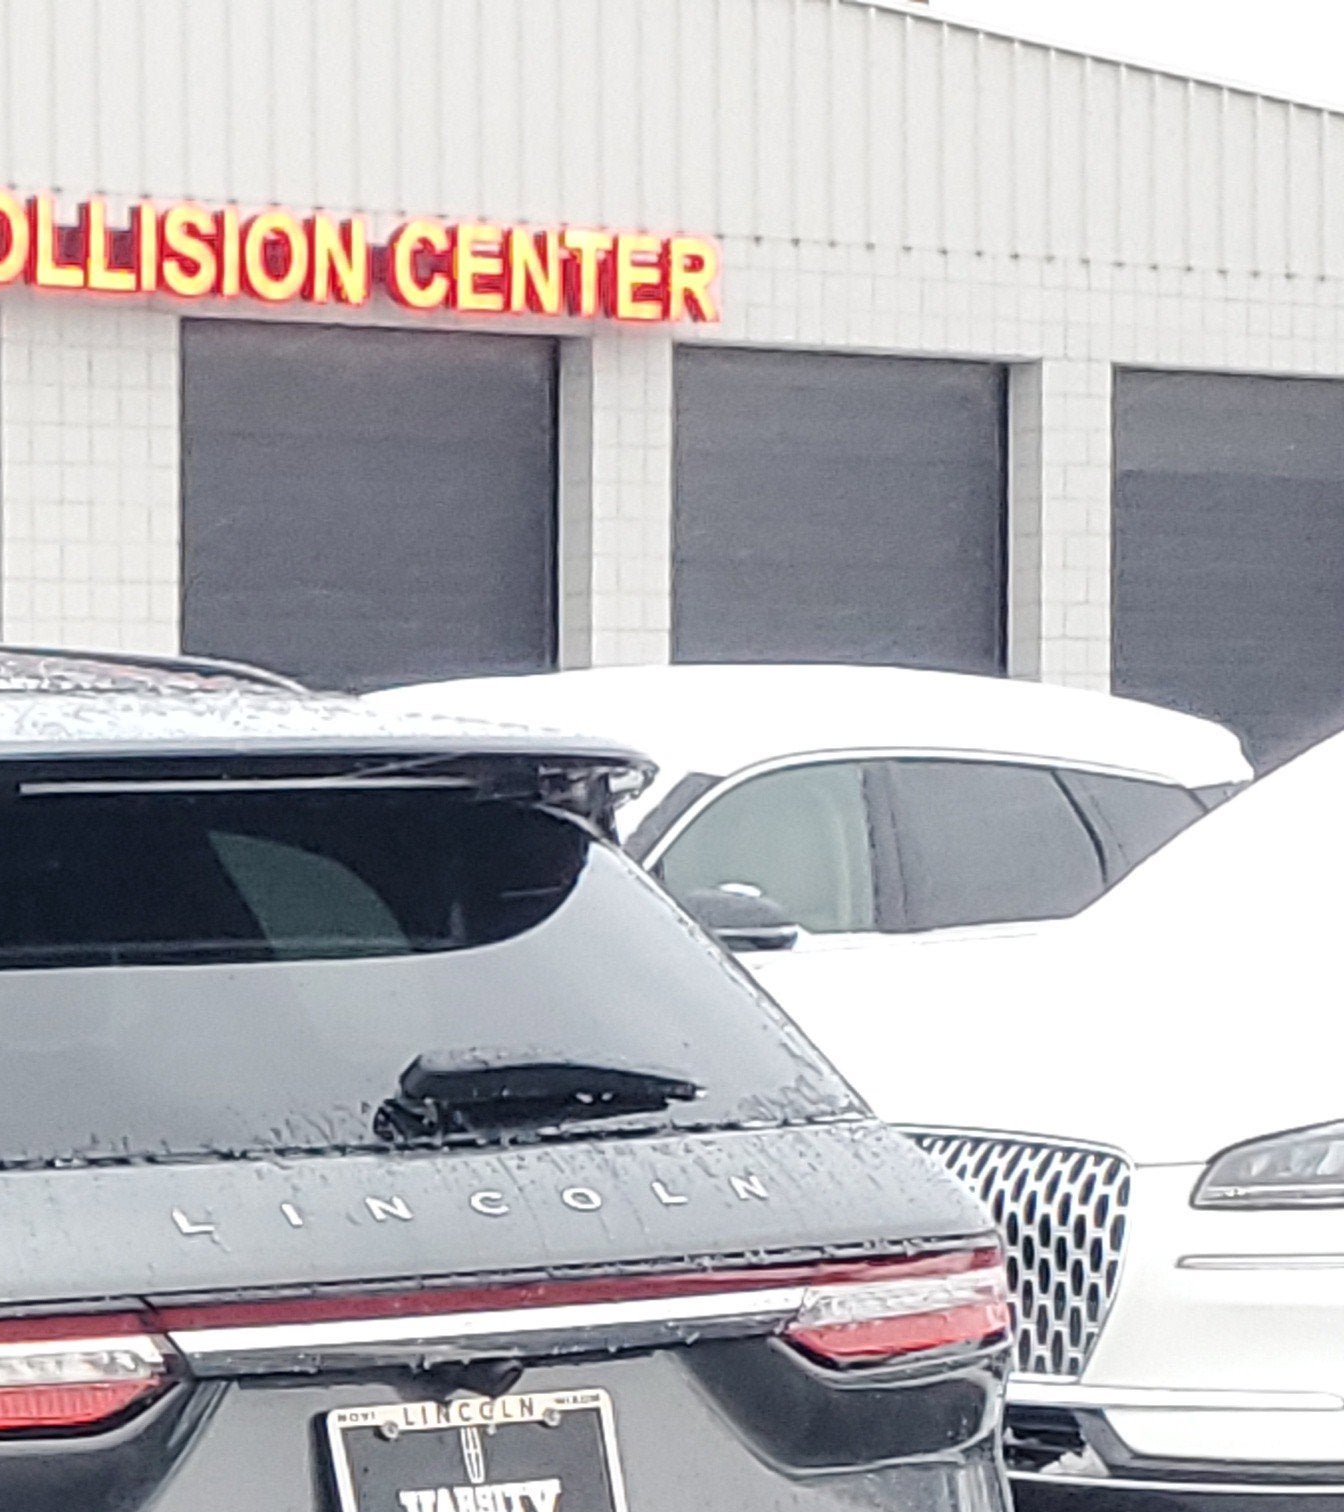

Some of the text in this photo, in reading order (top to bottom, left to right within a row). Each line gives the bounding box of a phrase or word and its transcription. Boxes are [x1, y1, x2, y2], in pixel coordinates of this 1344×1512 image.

[387, 219, 720, 324] CENTER
[171, 1172, 769, 1235] LINCOLN
[402, 1398, 535, 1427] LINCOLN
